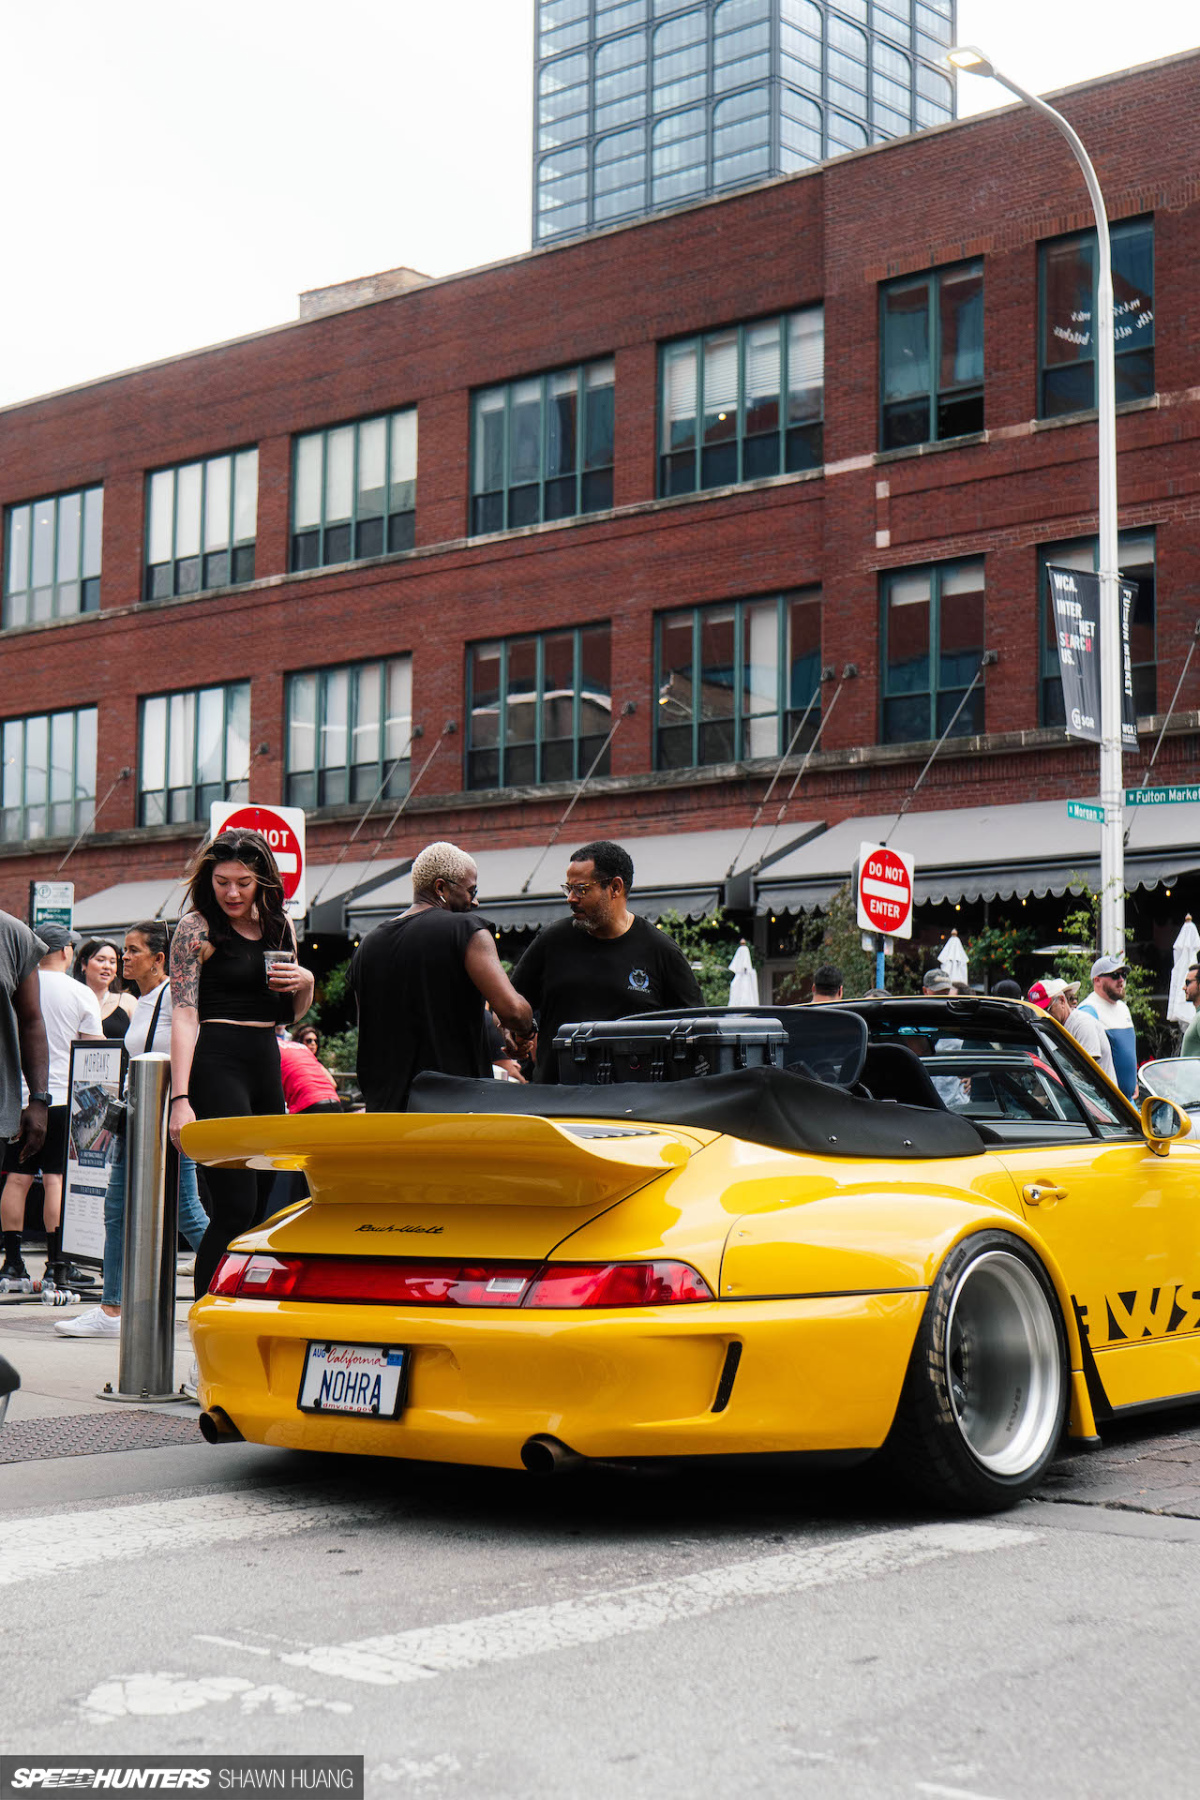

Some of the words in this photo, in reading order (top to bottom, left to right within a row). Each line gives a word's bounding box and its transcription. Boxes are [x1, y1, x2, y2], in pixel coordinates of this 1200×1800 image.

[1059, 630, 1092, 653] SEARCH
[1060, 647, 1075, 666] US.
[1136, 790, 1166, 803] Fulton
[1074, 804, 1097, 821] Morgan
[869, 861, 883, 878] DO
[885, 865, 904, 883] NOT
[870, 899, 900, 919] ENTER
[327, 1347, 387, 1370] California
[319, 1369, 381, 1407] NOHRA
